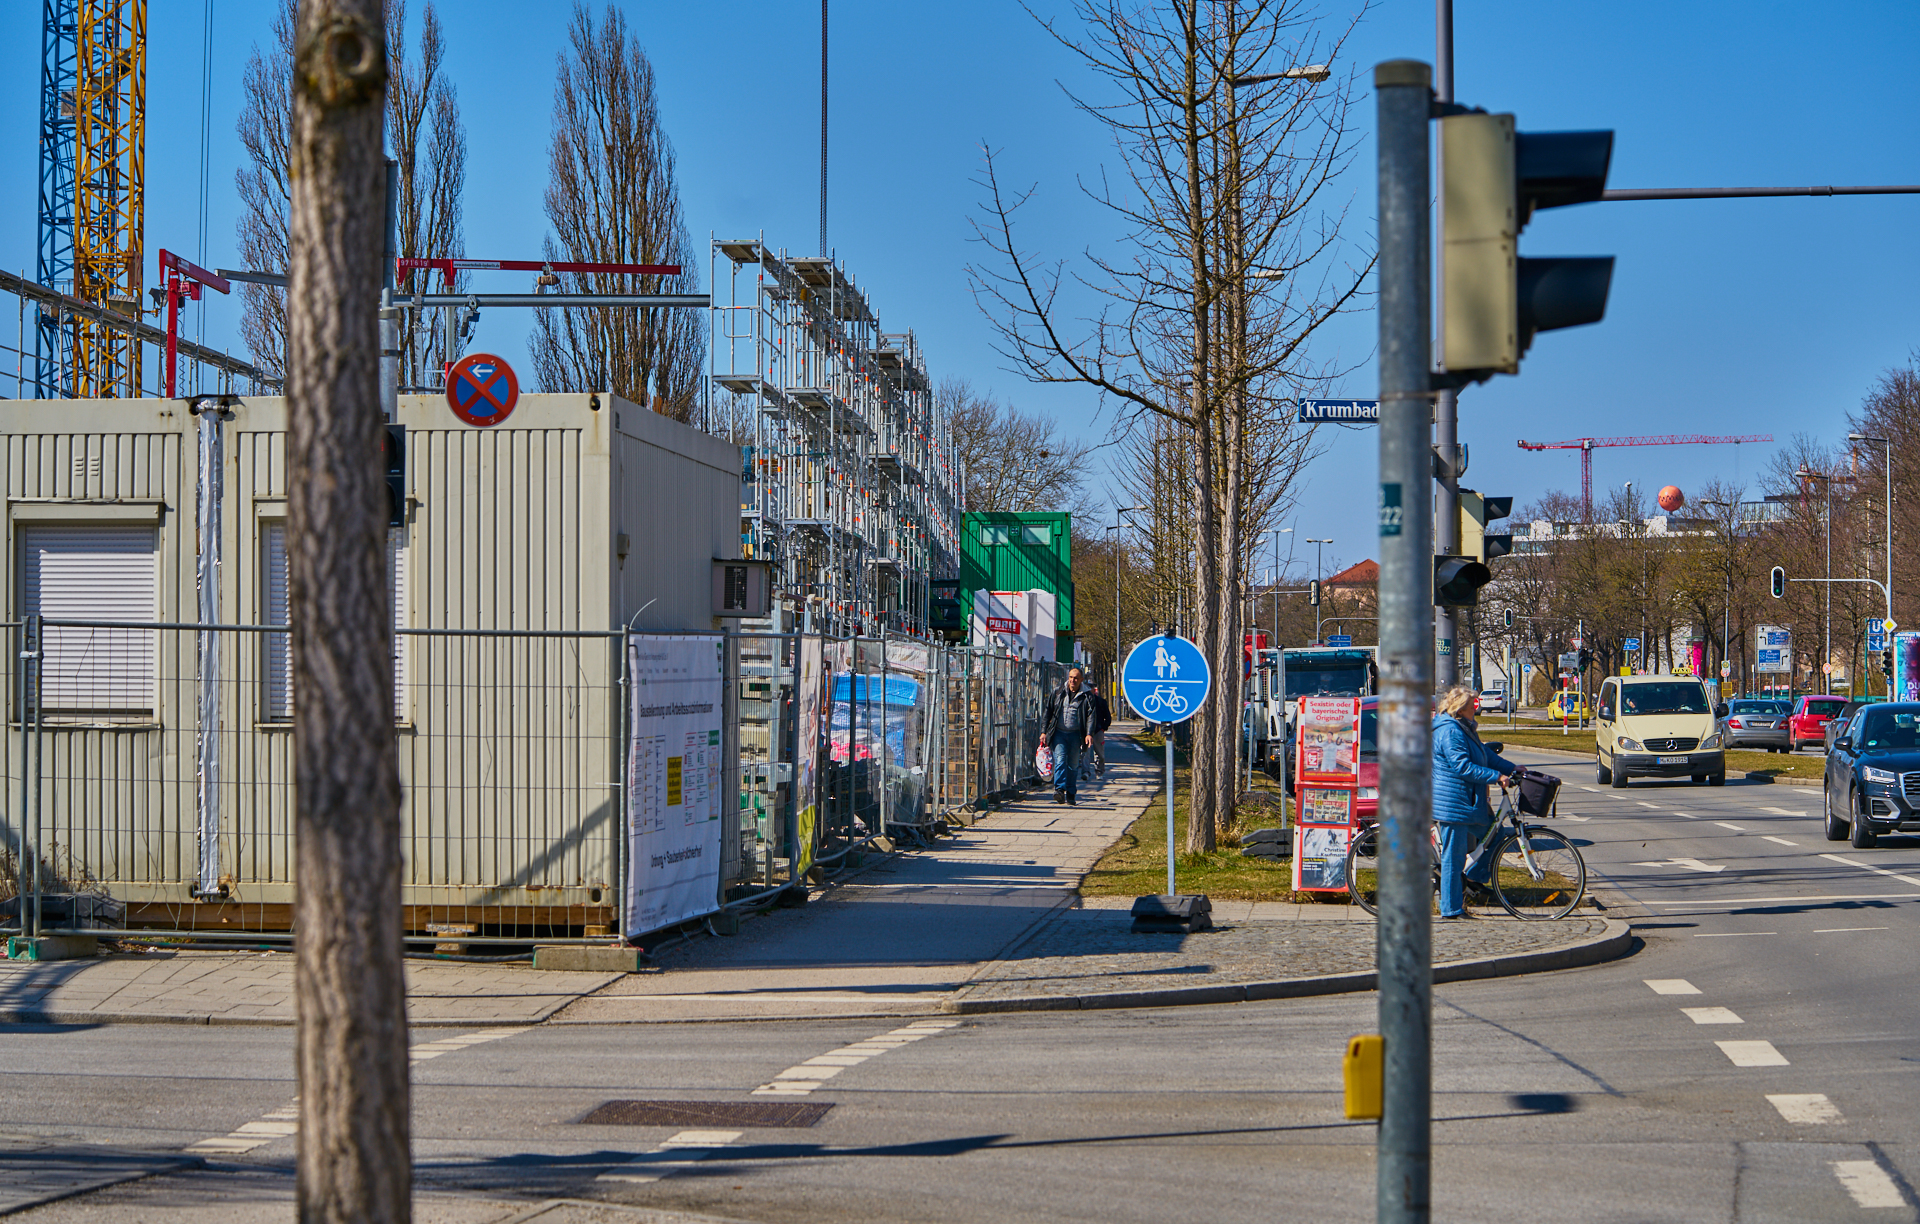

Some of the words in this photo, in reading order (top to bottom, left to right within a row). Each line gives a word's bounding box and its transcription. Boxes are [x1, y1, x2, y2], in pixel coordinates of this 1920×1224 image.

[1306, 401, 1380, 419] Krumbad
[989, 619, 1017, 629] PORIT
[1872, 620, 1881, 632] U
[1900, 693, 1918, 702] FAU
[1308, 753, 1317, 765] tz
